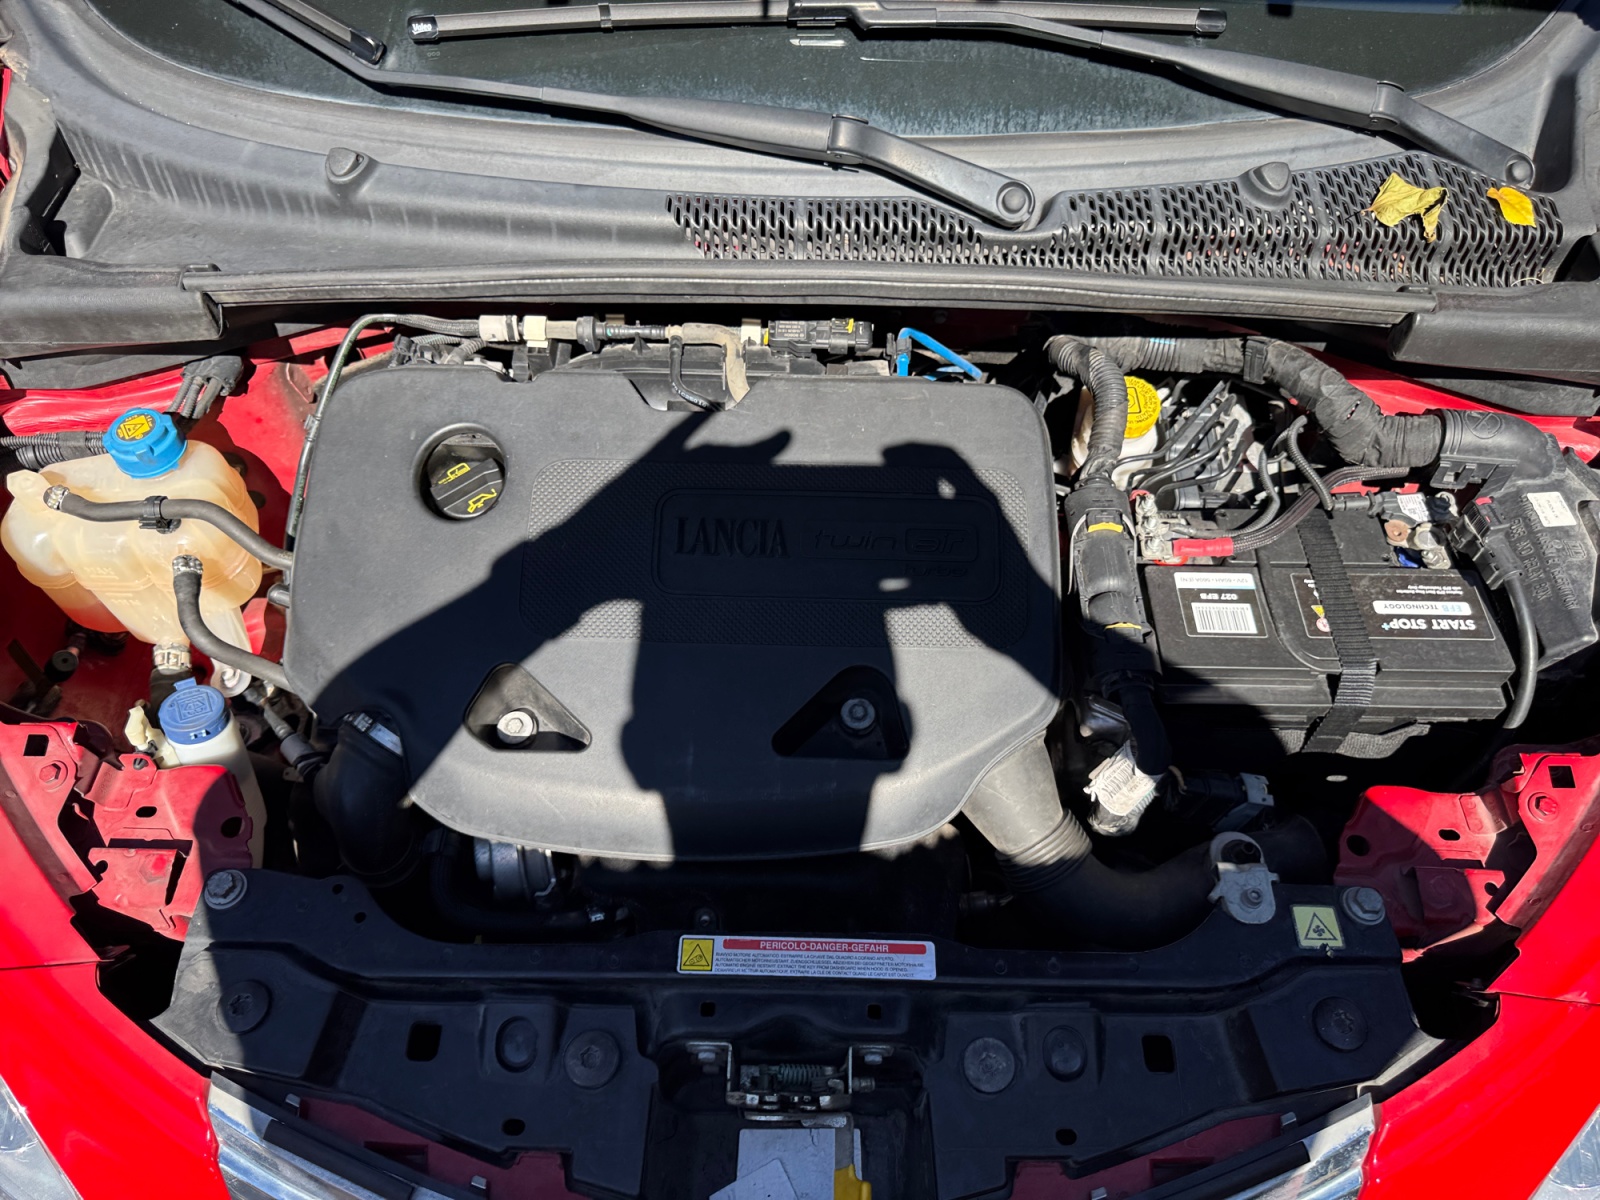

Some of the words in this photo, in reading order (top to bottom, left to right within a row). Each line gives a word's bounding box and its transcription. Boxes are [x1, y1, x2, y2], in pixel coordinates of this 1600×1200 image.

[412, 22, 432, 32] Valeo
[672, 516, 792, 558] LANCIA
[814, 529, 896, 550] twin
[910, 532, 964, 554] air
[1516, 540, 1534, 556] AND
[902, 562, 968, 578] turbo
[1523, 556, 1546, 582] RELAY
[1532, 582, 1553, 601] BOX
[1441, 604, 1462, 612] EFB
[1432, 619, 1476, 630] START
[760, 941, 888, 952] PERICOLO-DANGER-GEFAHR
